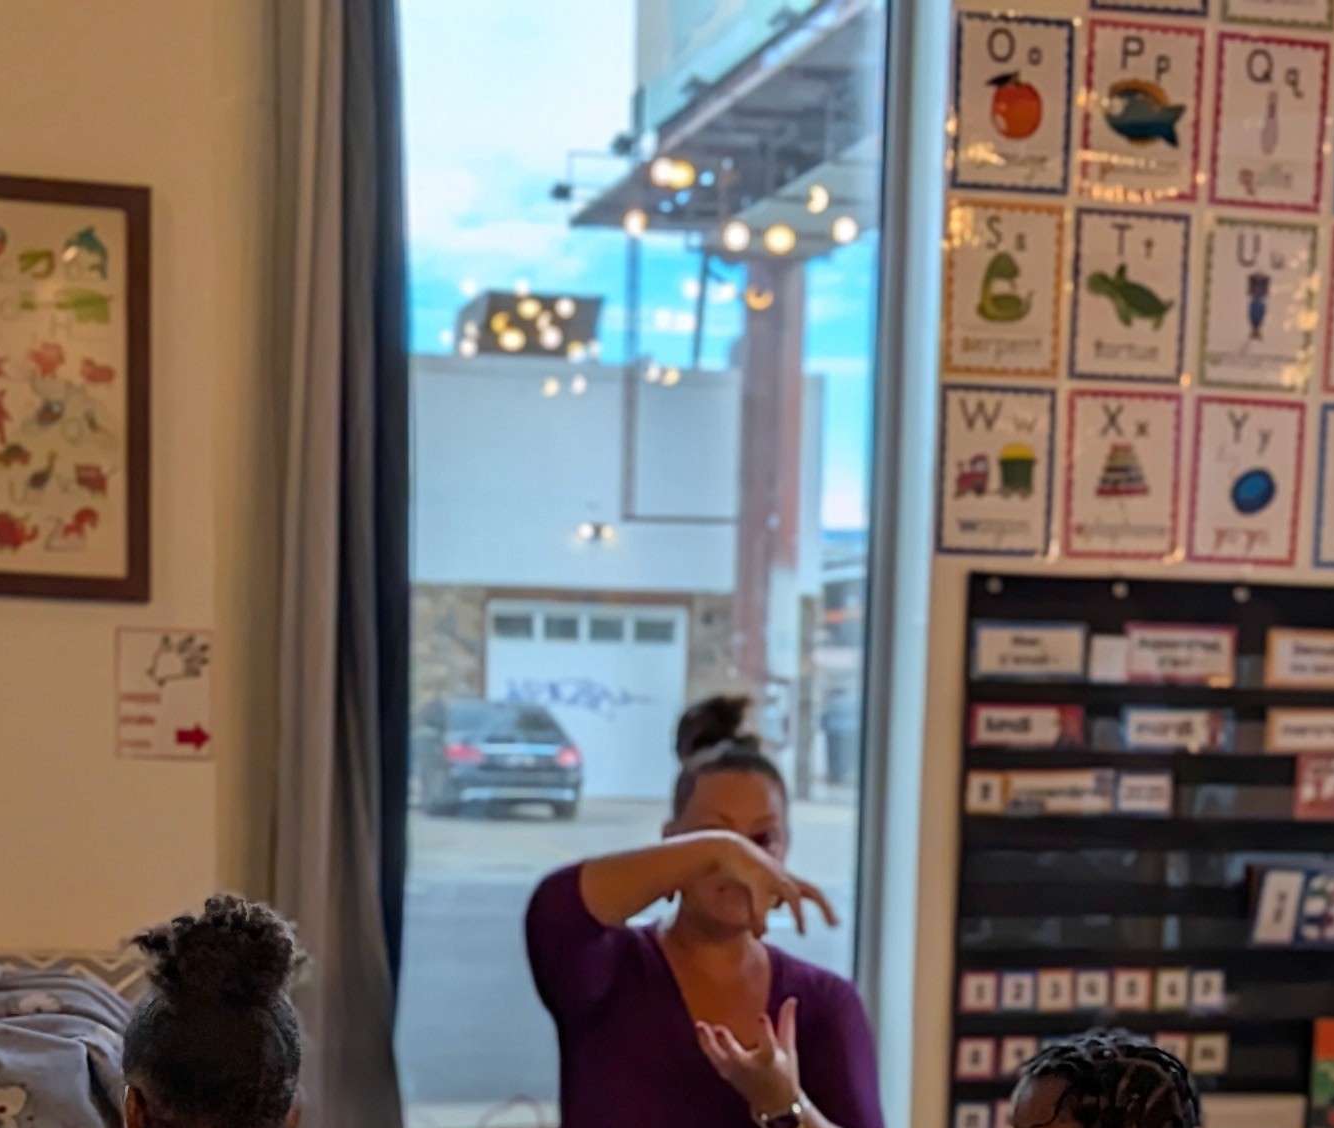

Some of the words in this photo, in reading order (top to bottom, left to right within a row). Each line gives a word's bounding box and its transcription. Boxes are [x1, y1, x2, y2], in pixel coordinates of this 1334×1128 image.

[988, 27, 1015, 63] O
[1028, 47, 1043, 66] o
[1120, 35, 1145, 69] P
[1155, 55, 1171, 83] p
[1246, 49, 1273, 84] Q
[986, 215, 1003, 250] S
[1111, 222, 1133, 257] T
[1236, 233, 1261, 268] U
[958, 398, 1002, 433] W
[1099, 403, 1124, 437] X
[1134, 420, 1150, 438] x
[1227, 410, 1250, 444] Y
[1258, 428, 1273, 456] y
